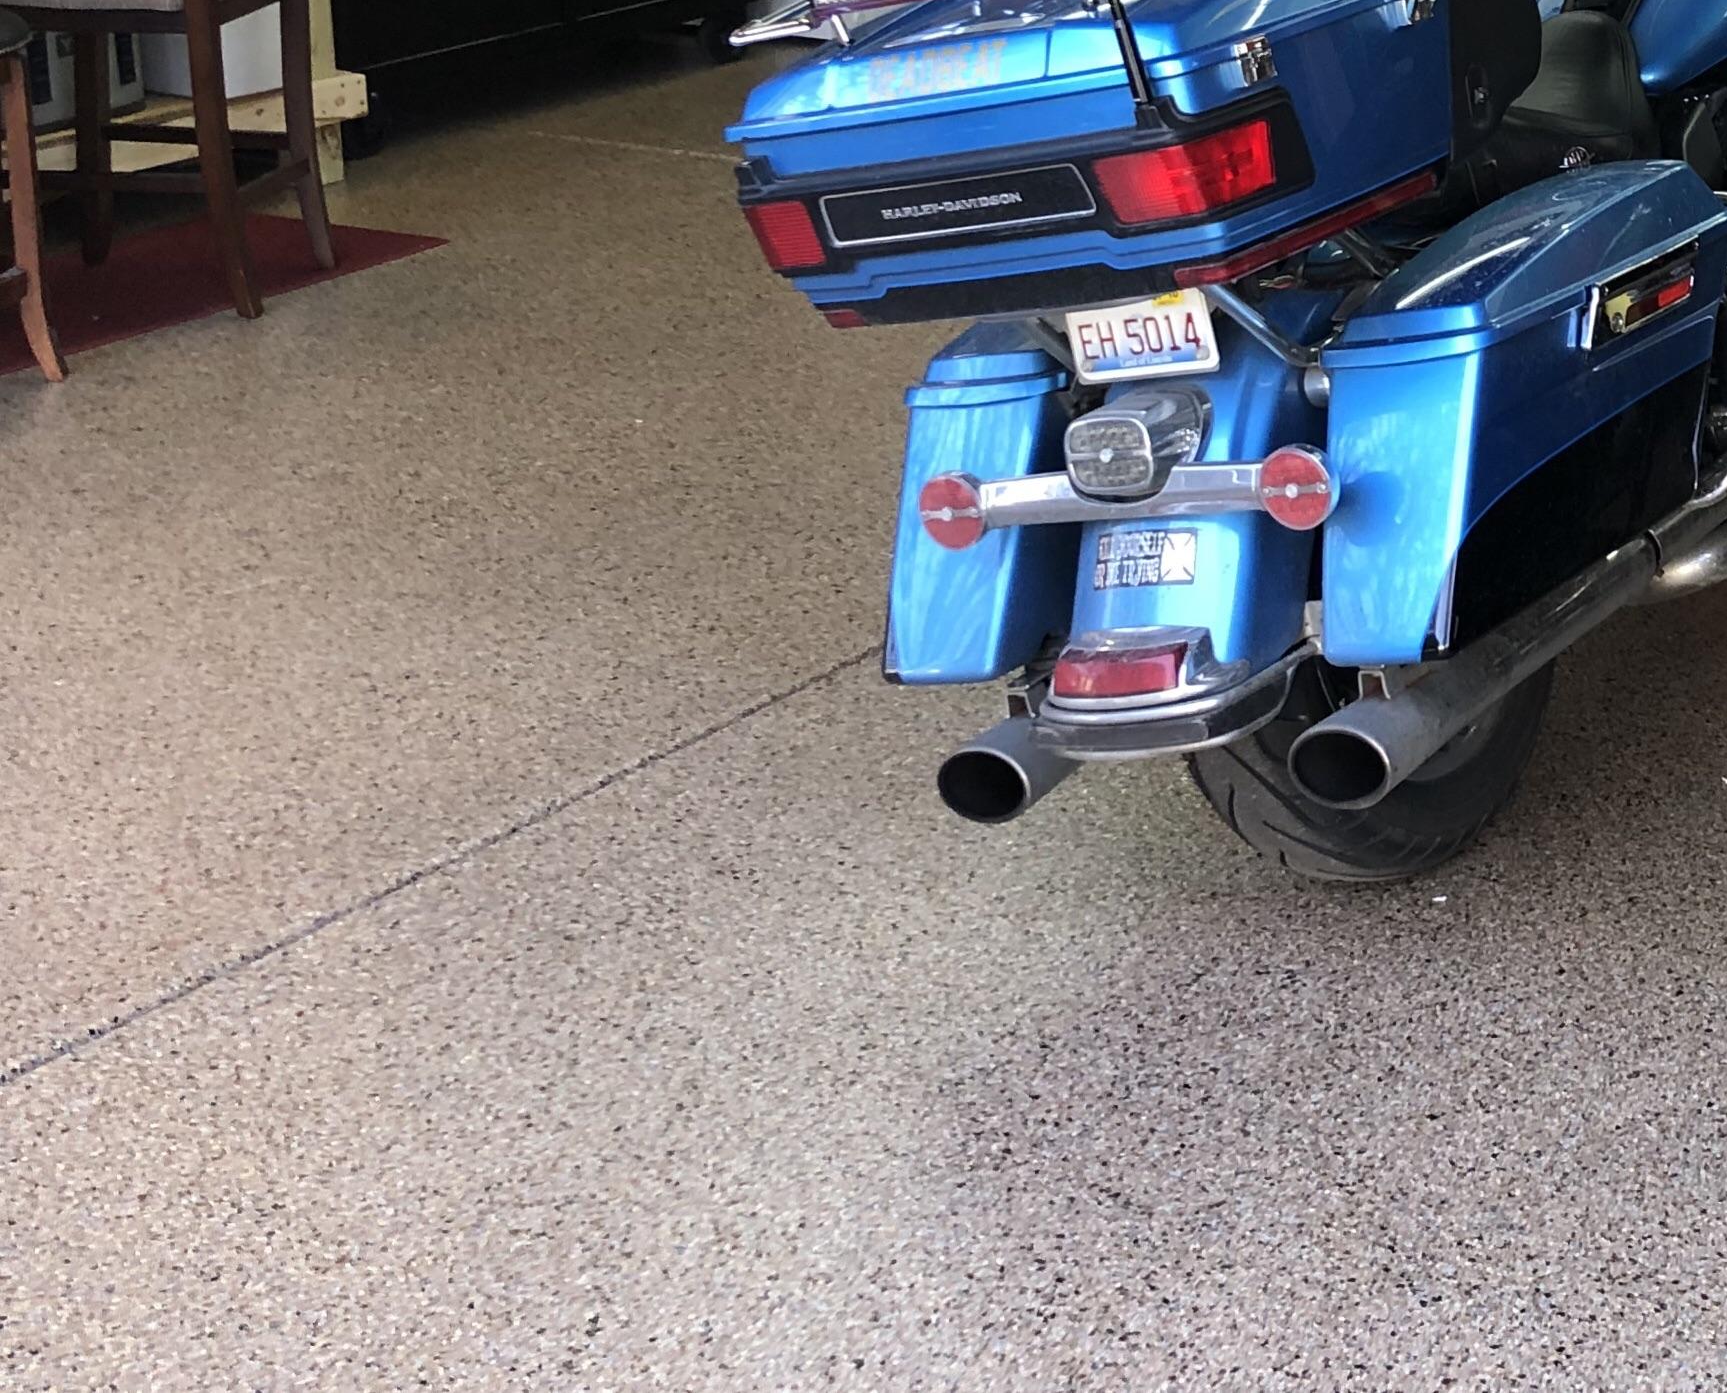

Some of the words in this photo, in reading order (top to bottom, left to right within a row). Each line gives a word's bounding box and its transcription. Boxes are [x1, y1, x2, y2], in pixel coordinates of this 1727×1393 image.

[880, 191, 1024, 221] HARLEY-DAVIDSON
[1078, 320, 1119, 360] EH
[1123, 312, 1201, 356] 5014
